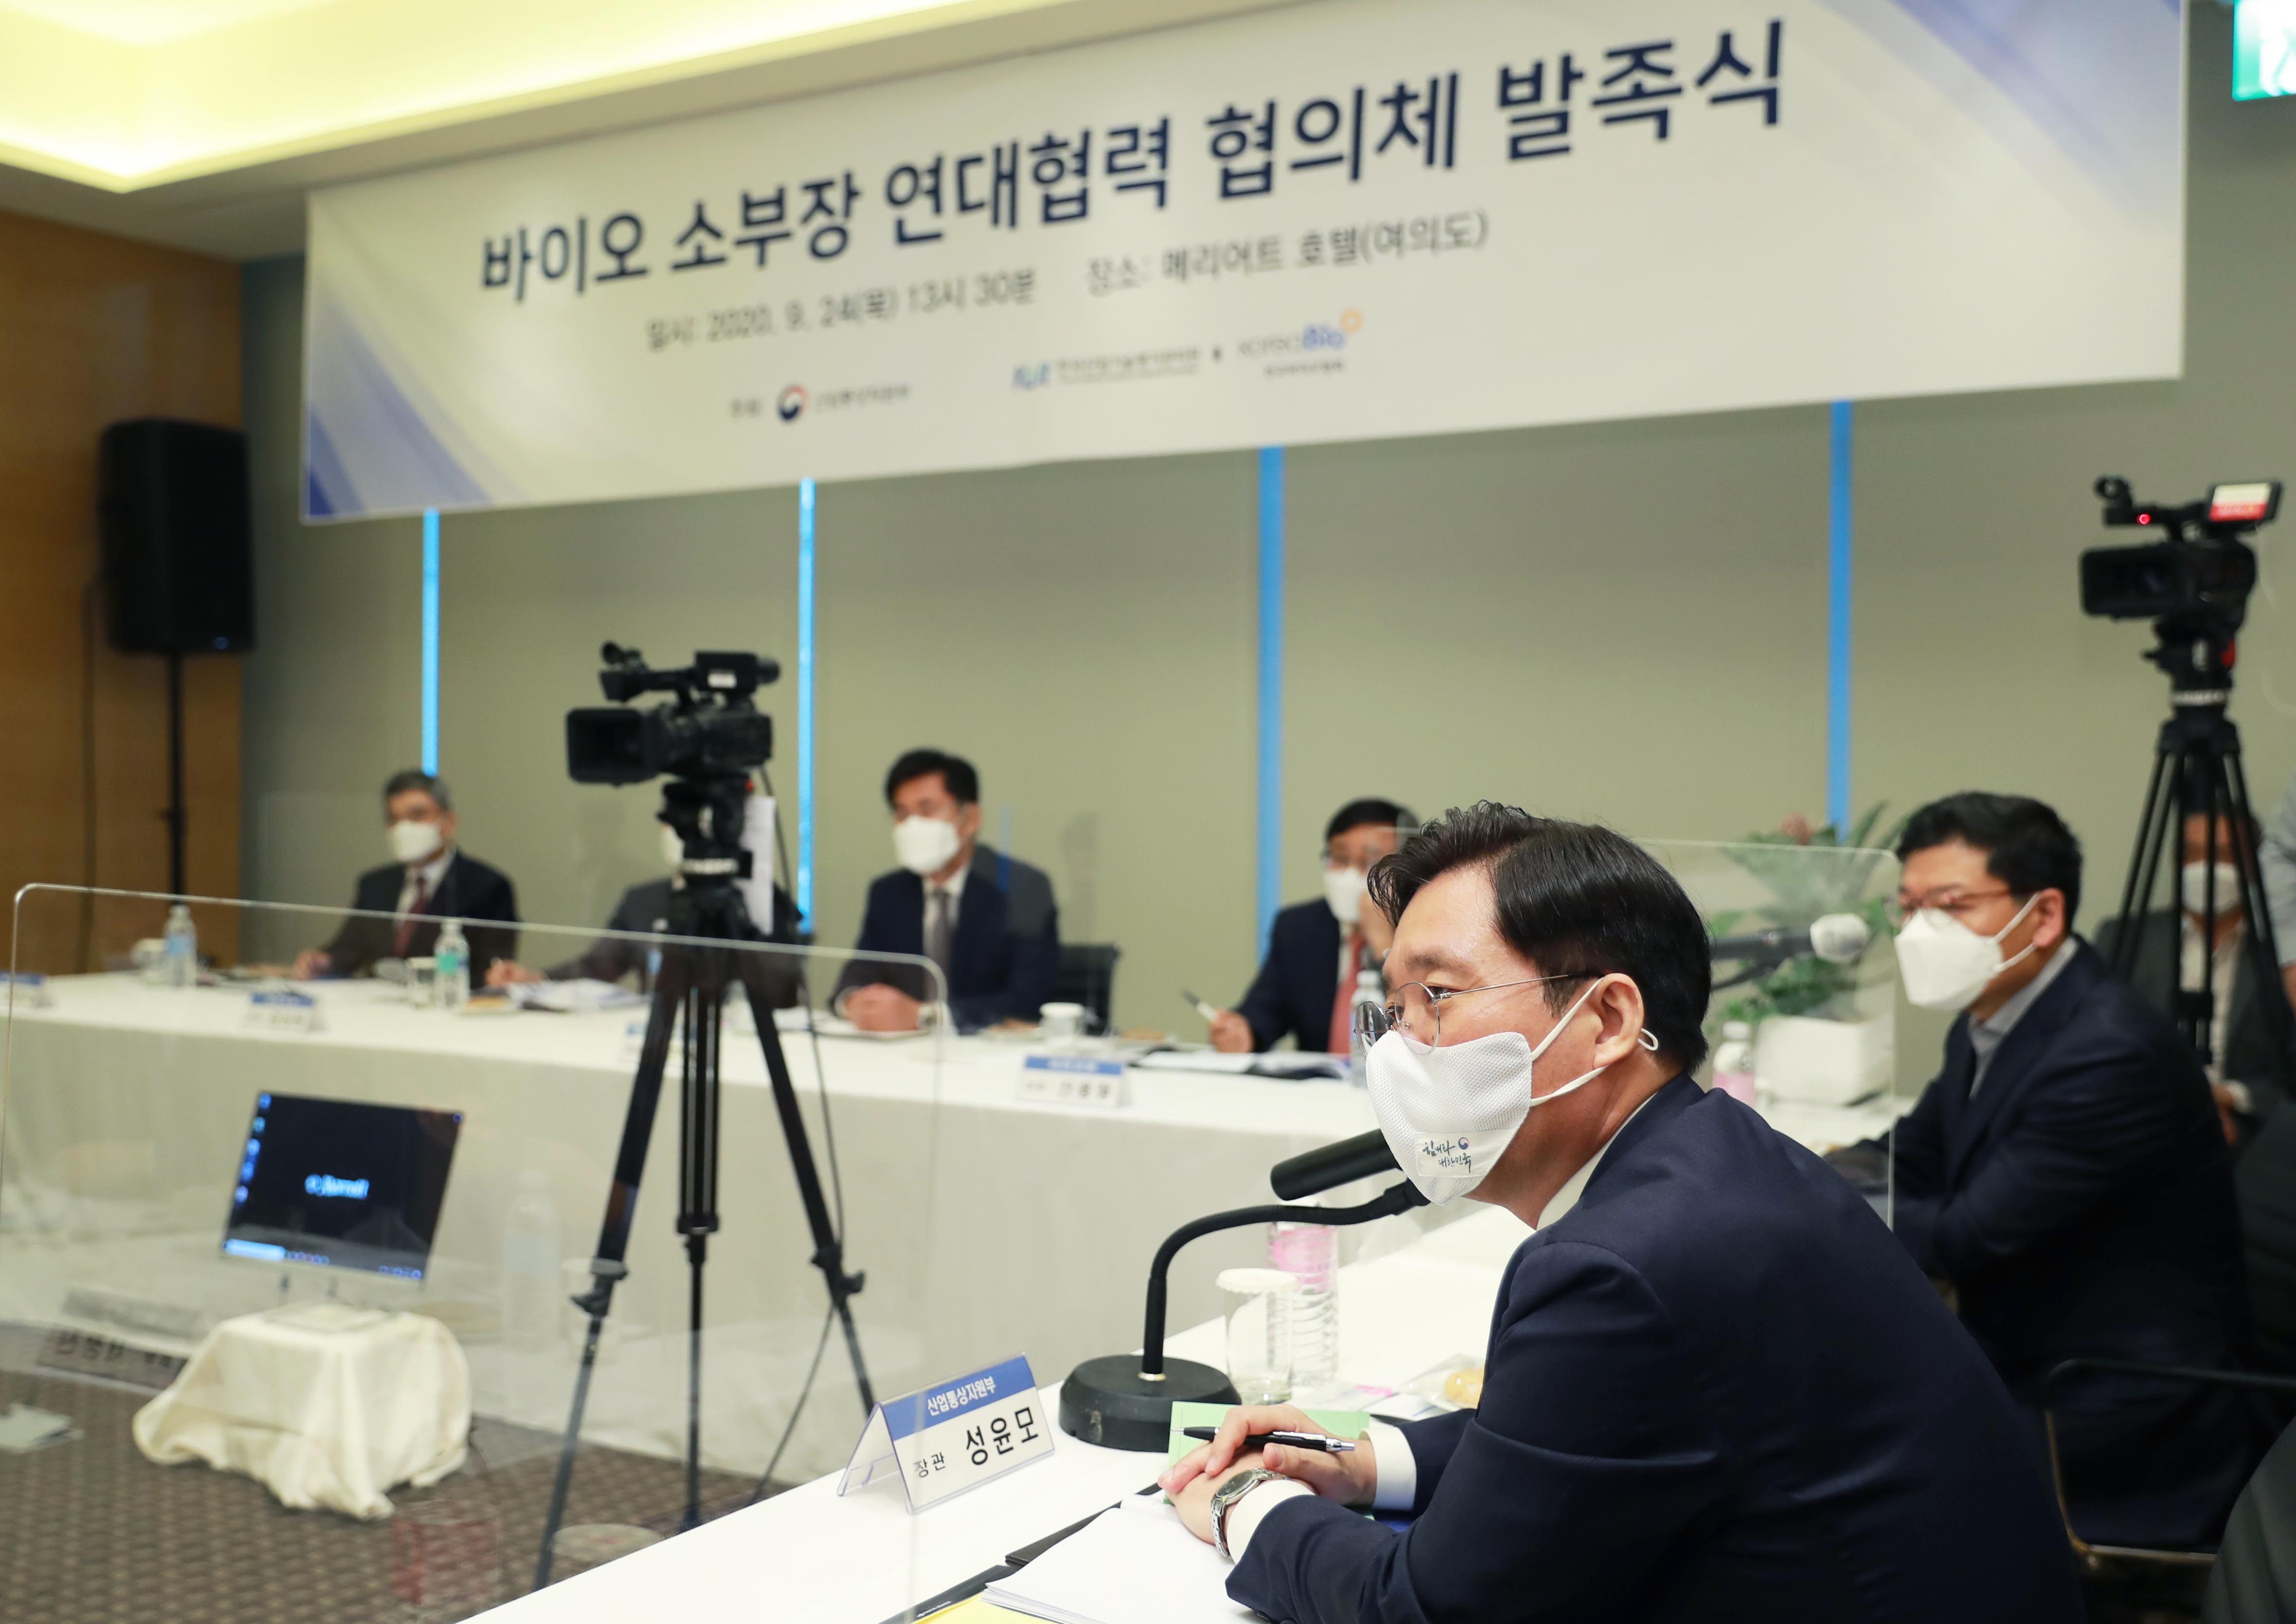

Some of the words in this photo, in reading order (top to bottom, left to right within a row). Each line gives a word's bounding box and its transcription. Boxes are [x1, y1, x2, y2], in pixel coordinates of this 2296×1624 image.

[481, 211, 650, 303] 바이오
[669, 170, 864, 272] 소부장
[884, 115, 1172, 247] 연대협력
[1205, 71, 1460, 201] 협의체
[1496, 18, 1784, 162] 발족식
[1160, 234, 1285, 284] 메리어트
[1295, 210, 1491, 269] 호텔(여의도)
[973, 267, 1036, 307] 30분
[927, 1376, 996, 1416] 산업통상자원부
[913, 1452, 945, 1478] 장관
[965, 1407, 1039, 1465] 성윤모
